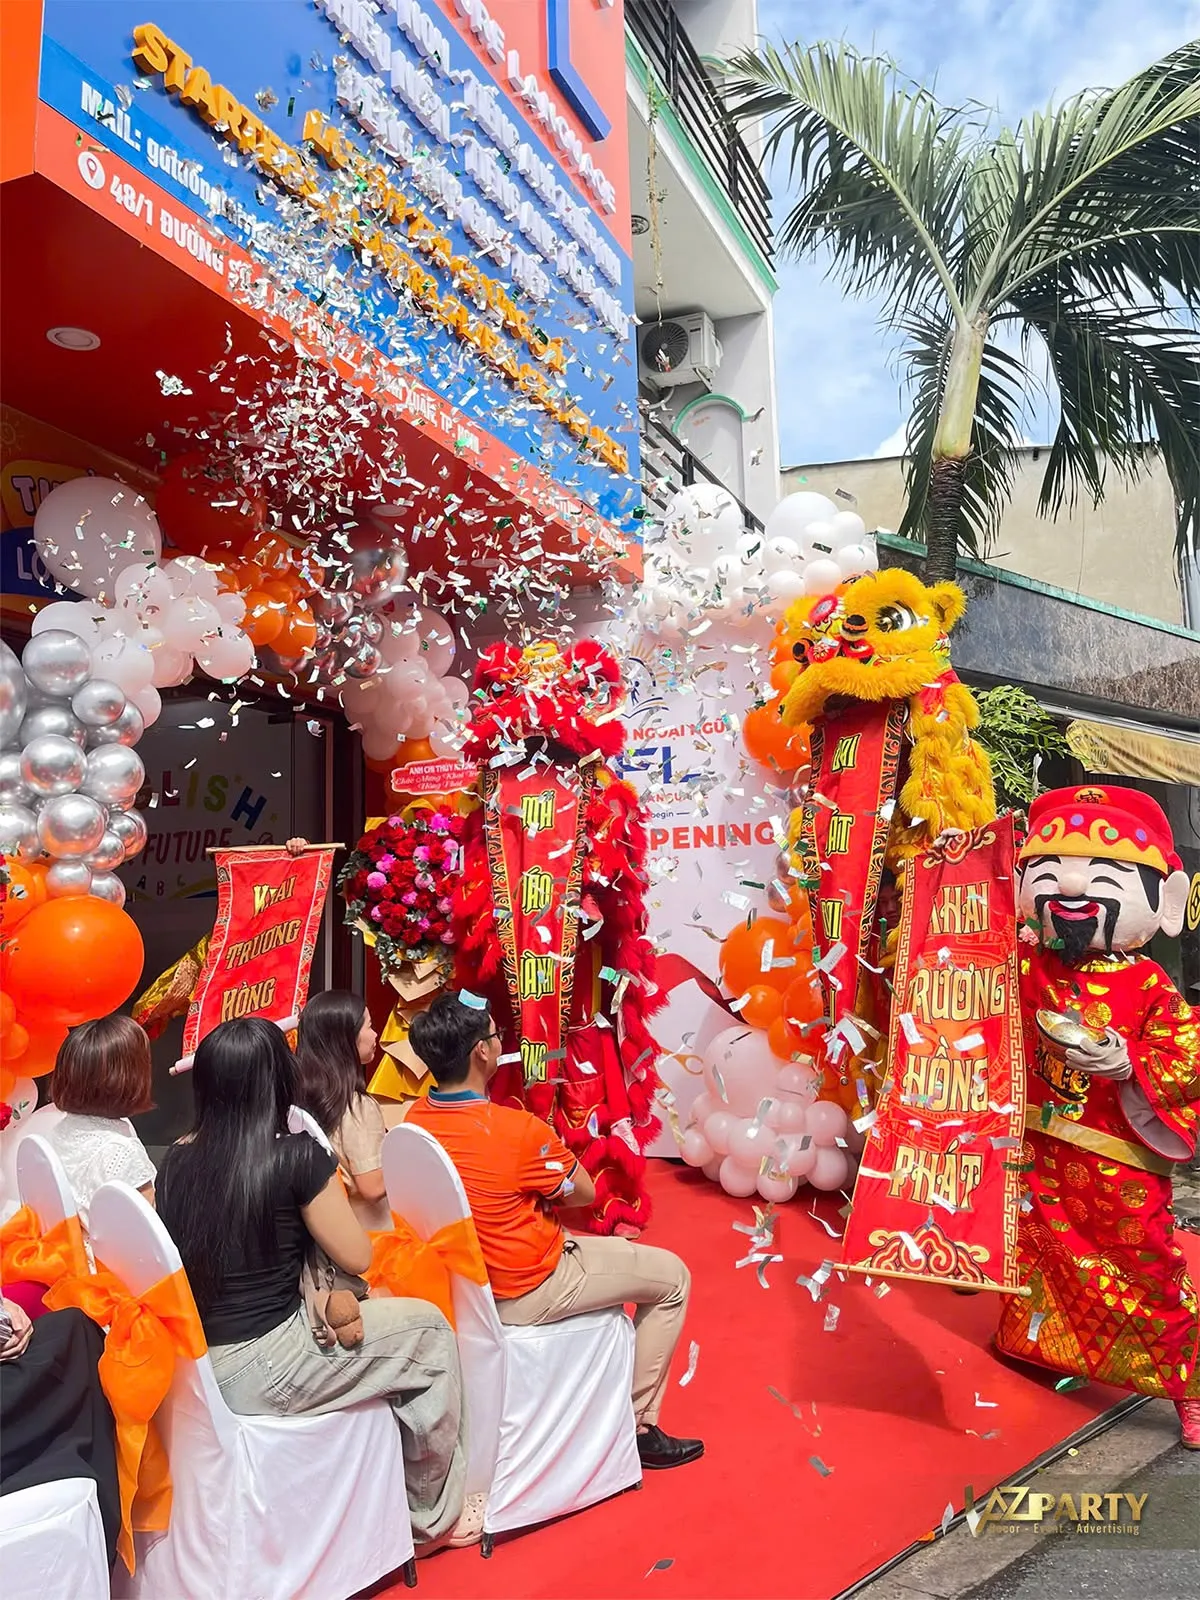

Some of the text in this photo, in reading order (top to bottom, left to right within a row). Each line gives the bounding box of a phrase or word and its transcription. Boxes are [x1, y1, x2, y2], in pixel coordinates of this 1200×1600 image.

[110, 175, 154, 226] 48/1
[650, 821, 778, 851] PENING
[889, 1138, 983, 1210] PHÁT
